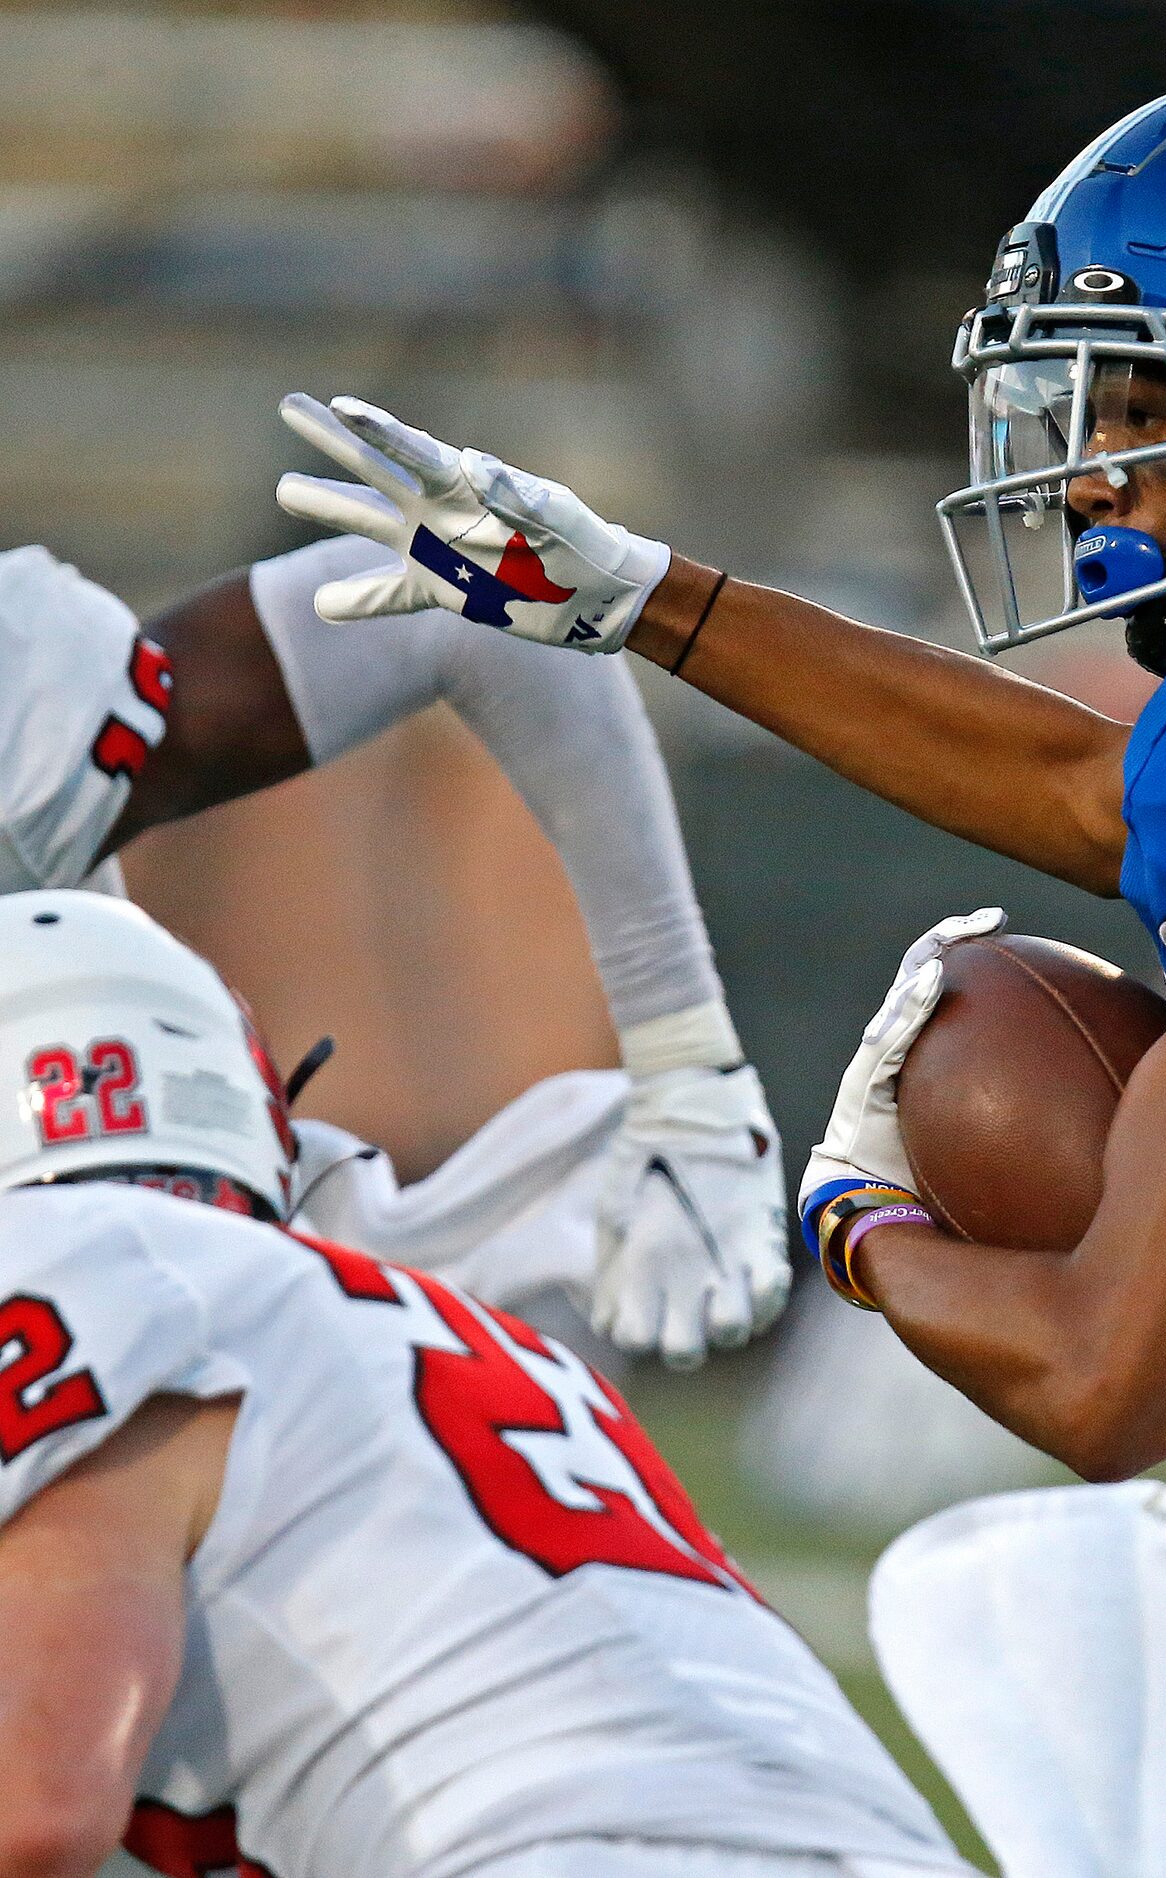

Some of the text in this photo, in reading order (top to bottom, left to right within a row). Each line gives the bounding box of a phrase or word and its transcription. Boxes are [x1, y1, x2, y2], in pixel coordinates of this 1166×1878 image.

[27, 1035, 149, 1147] 22
[869, 1207, 932, 1223] ber Creek
